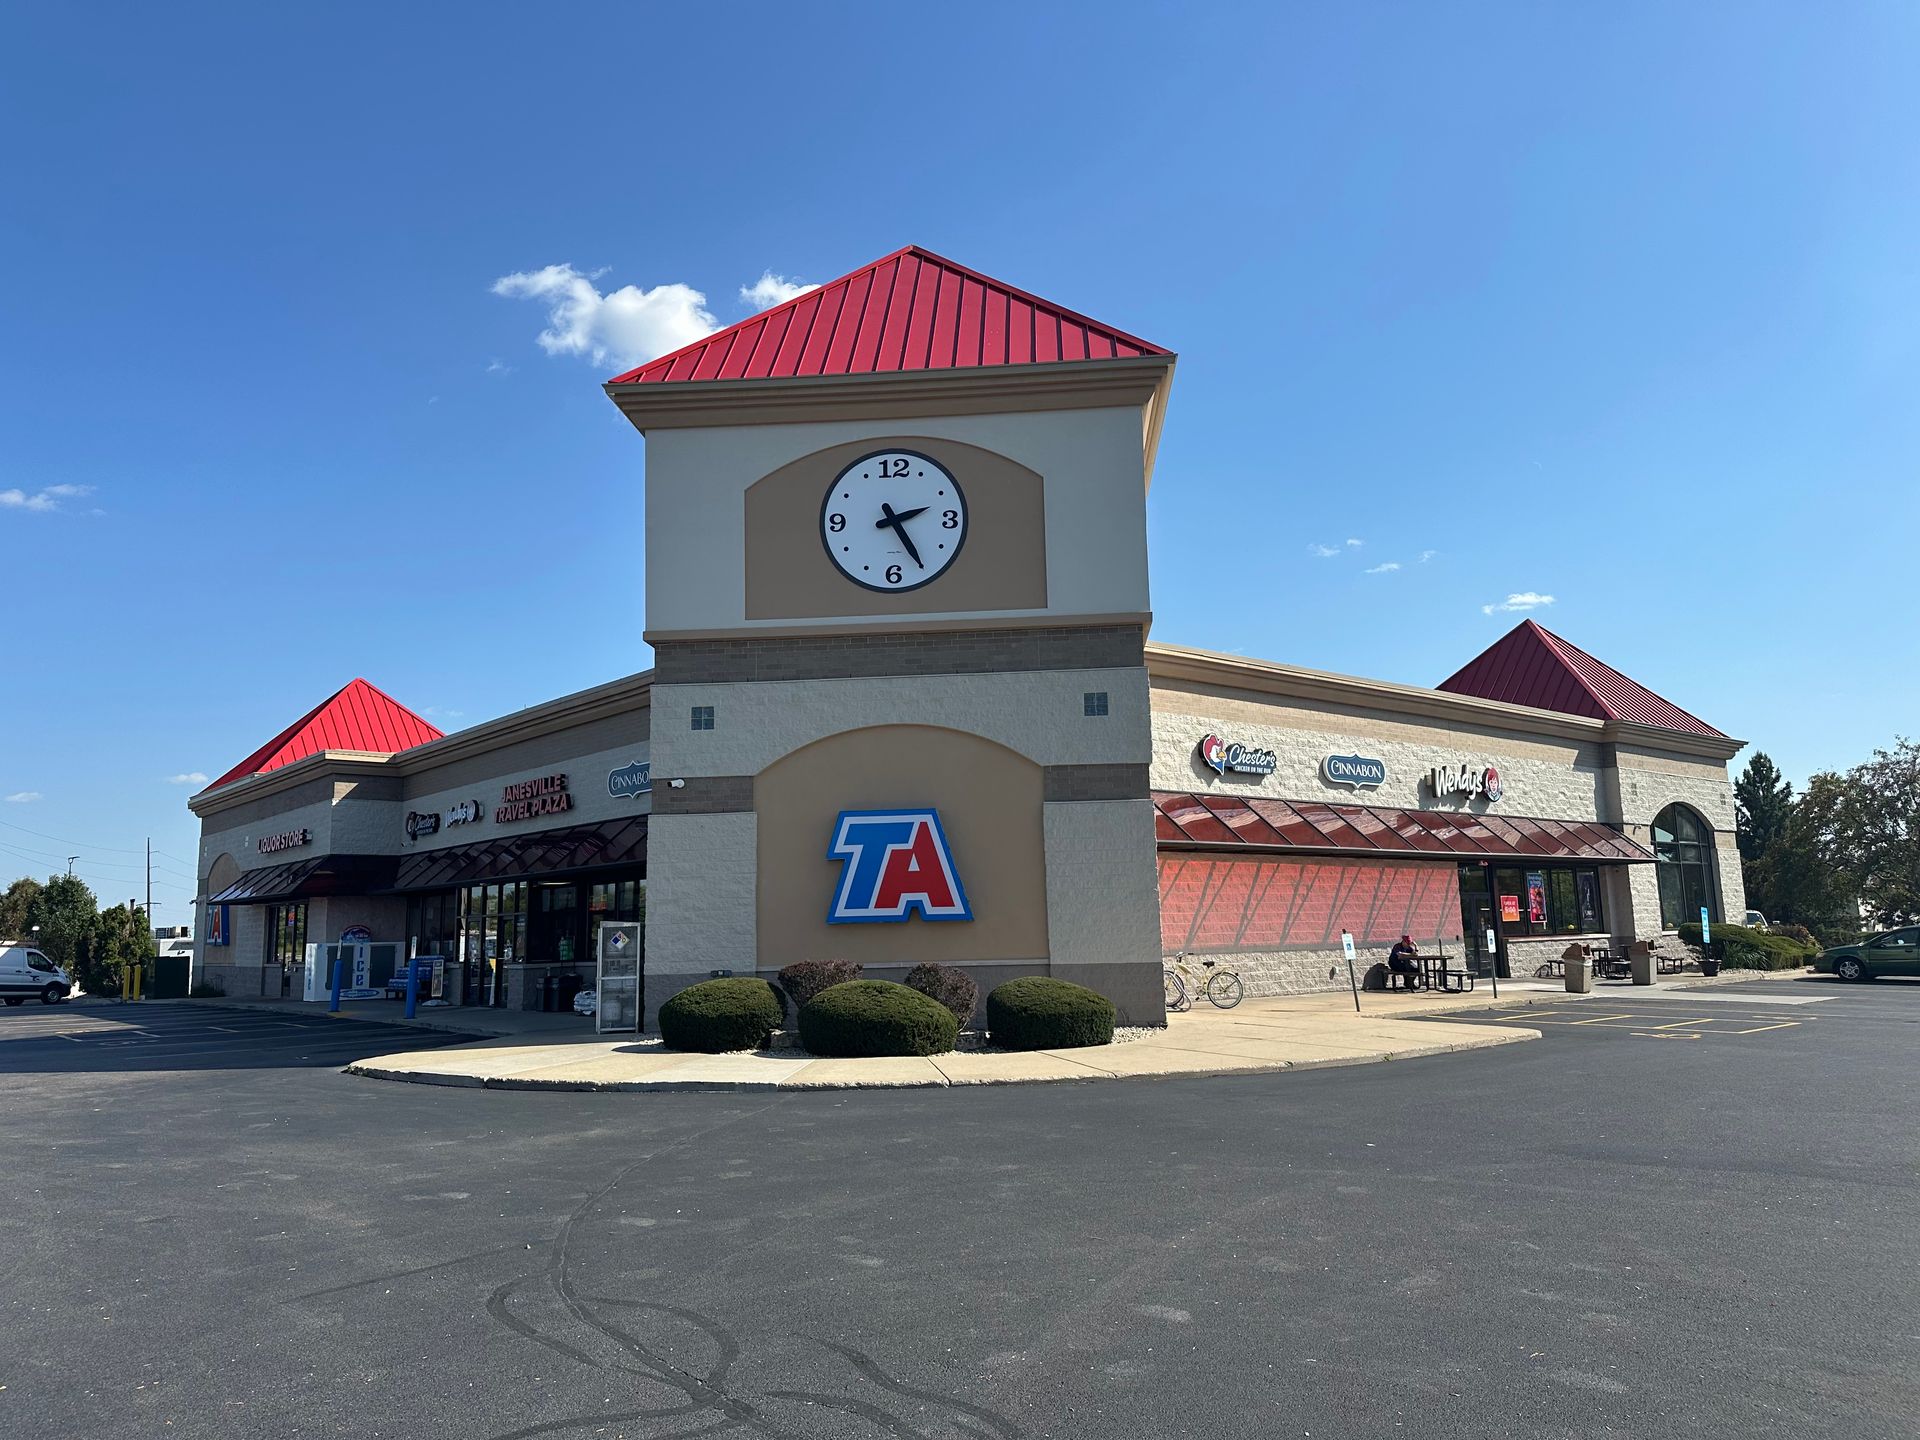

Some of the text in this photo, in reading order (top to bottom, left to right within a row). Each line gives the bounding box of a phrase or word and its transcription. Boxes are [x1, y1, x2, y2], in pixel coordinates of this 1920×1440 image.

[878, 458, 910, 479] 12
[829, 513, 846, 532] 9
[942, 510, 958, 529] 3
[885, 564, 903, 584] 6
[1229, 744, 1276, 767] Chester's
[1331, 760, 1382, 779] CINNABON
[502, 774, 562, 803] JANESVILLE
[611, 771, 650, 791] CINNABO
[1435, 765, 1483, 800] Wendy's
[494, 794, 568, 823] TRAVEL PLAZA
[257, 830, 303, 854] LIQUOR STORE
[832, 813, 967, 918] TA
